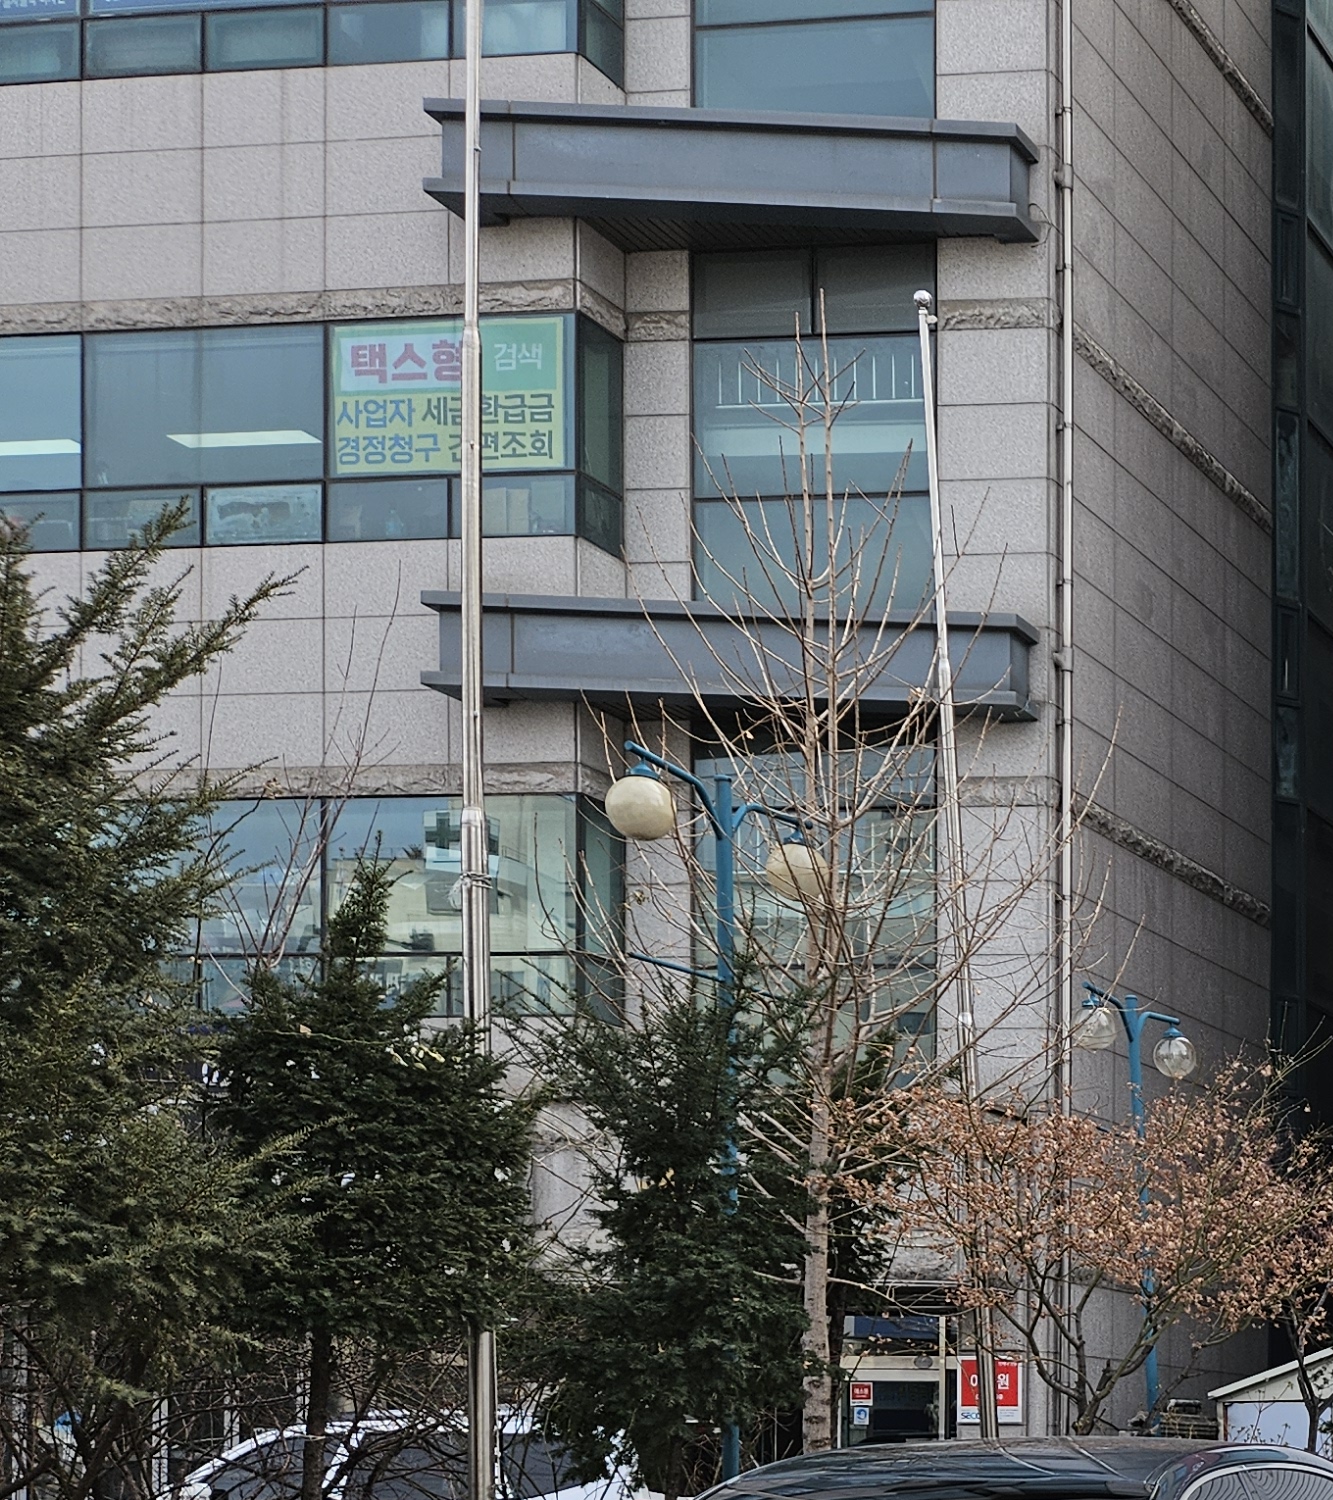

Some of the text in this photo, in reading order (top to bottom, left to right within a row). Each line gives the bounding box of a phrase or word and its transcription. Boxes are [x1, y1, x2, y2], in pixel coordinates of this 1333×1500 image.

[493, 342, 543, 371] 검색
[336, 399, 415, 429] 사업자
[337, 433, 441, 465] 경정청구
